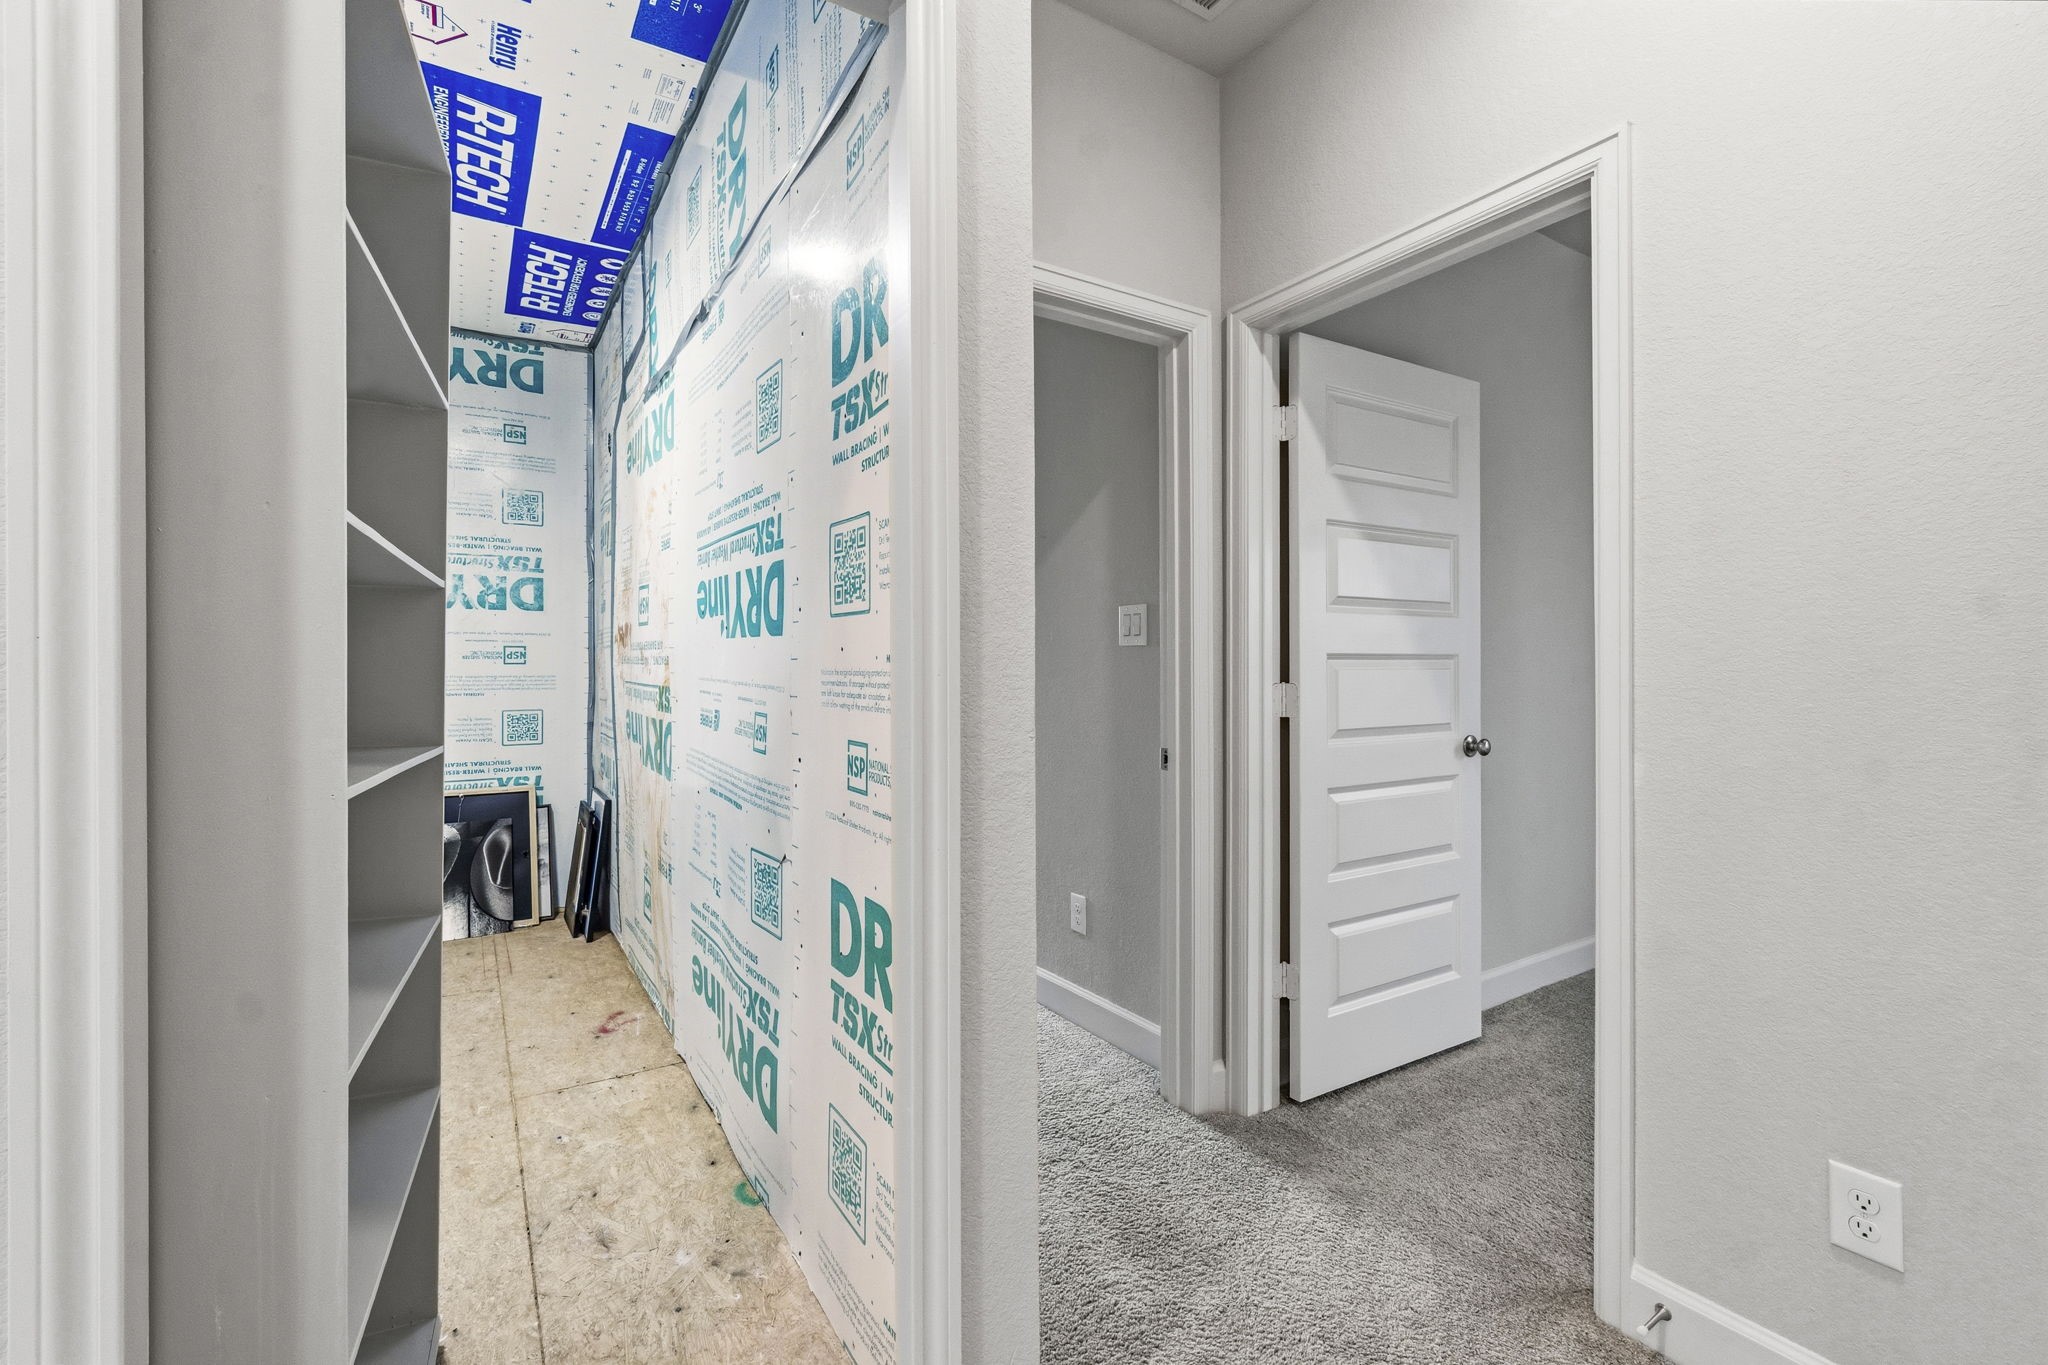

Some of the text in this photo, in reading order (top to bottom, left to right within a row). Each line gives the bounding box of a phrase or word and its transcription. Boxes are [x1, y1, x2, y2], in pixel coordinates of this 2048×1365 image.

[489, 22, 522, 70] Henry
[456, 92, 517, 214] R-TECH
[716, 121, 727, 207] TSX
[847, 134, 862, 172] NSP
[759, 240, 771, 264] NSP
[520, 241, 573, 314] R-TECH
[450, 347, 544, 395] DRY
[831, 368, 876, 441] TSX
[506, 430, 526, 440] NSP
[627, 389, 676, 475] DRYline
[832, 446, 850, 466] WALL
[850, 430, 877, 456] BRACING
[753, 497, 770, 512] BRACING
[471, 536, 512, 544] STRUCTURAL
[755, 513, 784, 557] TSX
[497, 555, 544, 574] TSX
[447, 574, 544, 612] DRY
[697, 559, 784, 639] DRYline
[506, 651, 526, 660] NSP
[658, 686, 672, 714] SX
[626, 710, 673, 782] DRYline
[755, 725, 767, 743] NSP
[848, 754, 865, 779] NSP
[869, 759, 889, 774] NATIONAL
[831, 877, 893, 1014] DR
[746, 962, 767, 989] BRACING
[767, 979, 780, 999] WALL
[746, 985, 780, 1048] TSX
[830, 978, 878, 1057] TSX
[692, 955, 778, 1134] DRYline
[831, 1034, 847, 1059] WALL
[848, 1051, 878, 1088] BRACING
[858, 1083, 893, 1128] STRUCTUR
[876, 1171, 892, 1195] SCAN
